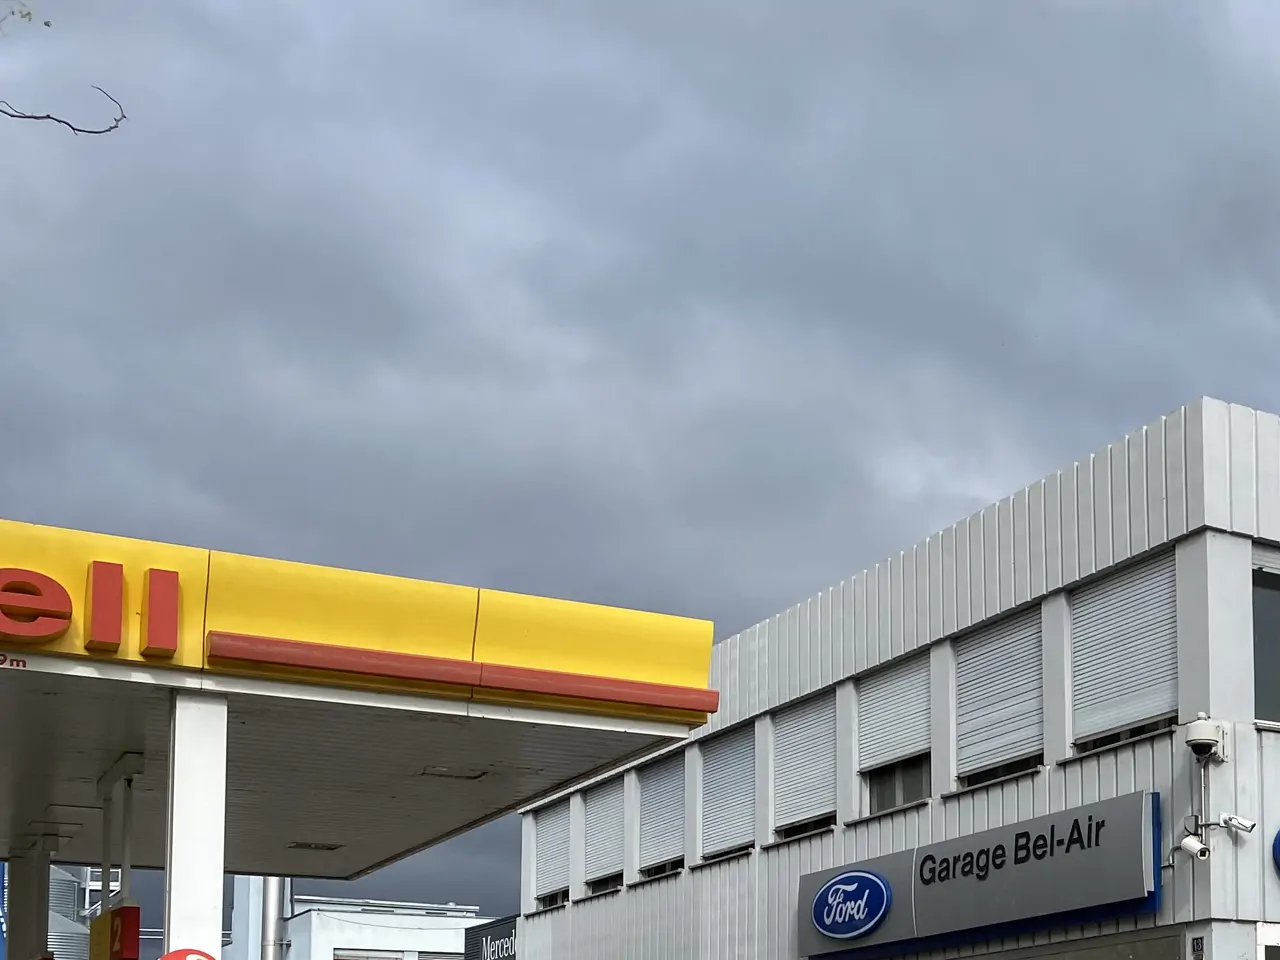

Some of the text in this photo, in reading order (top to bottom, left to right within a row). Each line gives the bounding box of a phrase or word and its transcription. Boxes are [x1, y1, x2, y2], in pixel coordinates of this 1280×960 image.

[919, 815, 1105, 885] Garage Bel-Air
[823, 882, 870, 926] Ford
[113, 917, 122, 951] 2
[1193, 938, 1202, 951] 13
